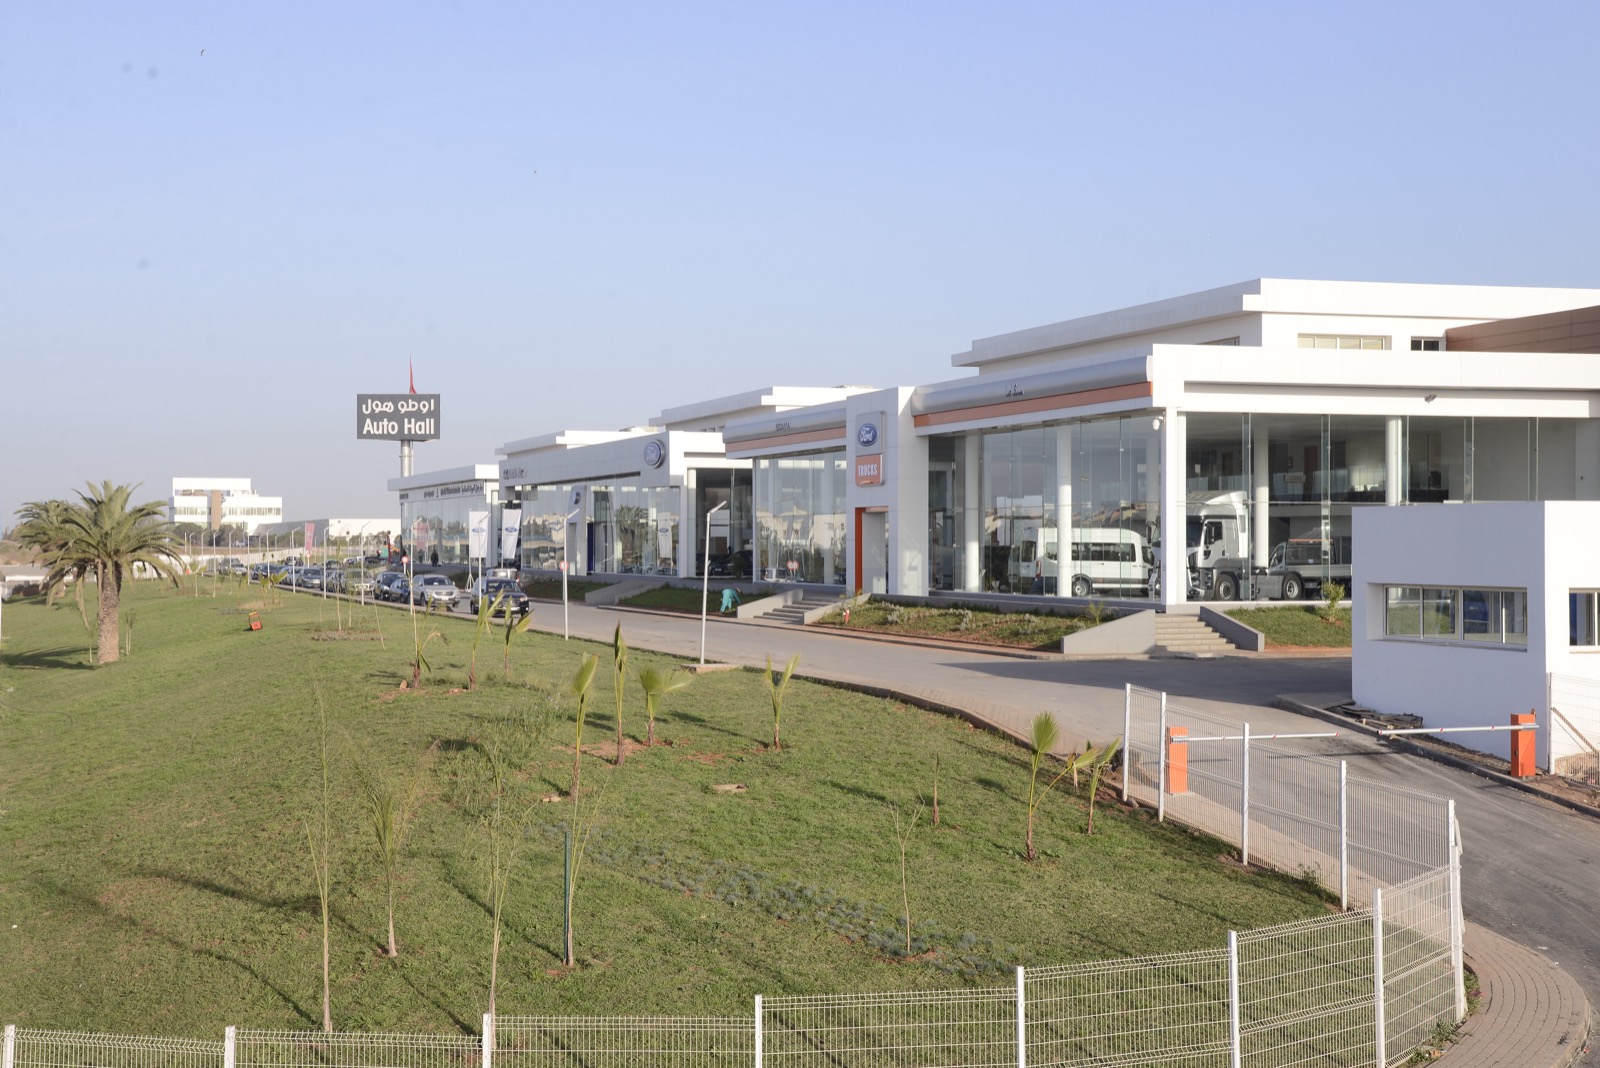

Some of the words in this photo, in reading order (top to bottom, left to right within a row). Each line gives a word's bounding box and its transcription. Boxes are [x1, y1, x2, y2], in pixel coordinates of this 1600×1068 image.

[362, 398, 395, 415] هول
[397, 398, 435, 414] اوطو
[362, 418, 399, 435] Auto
[404, 418, 435, 435] Hall
[857, 463, 878, 477] TRUCKS
